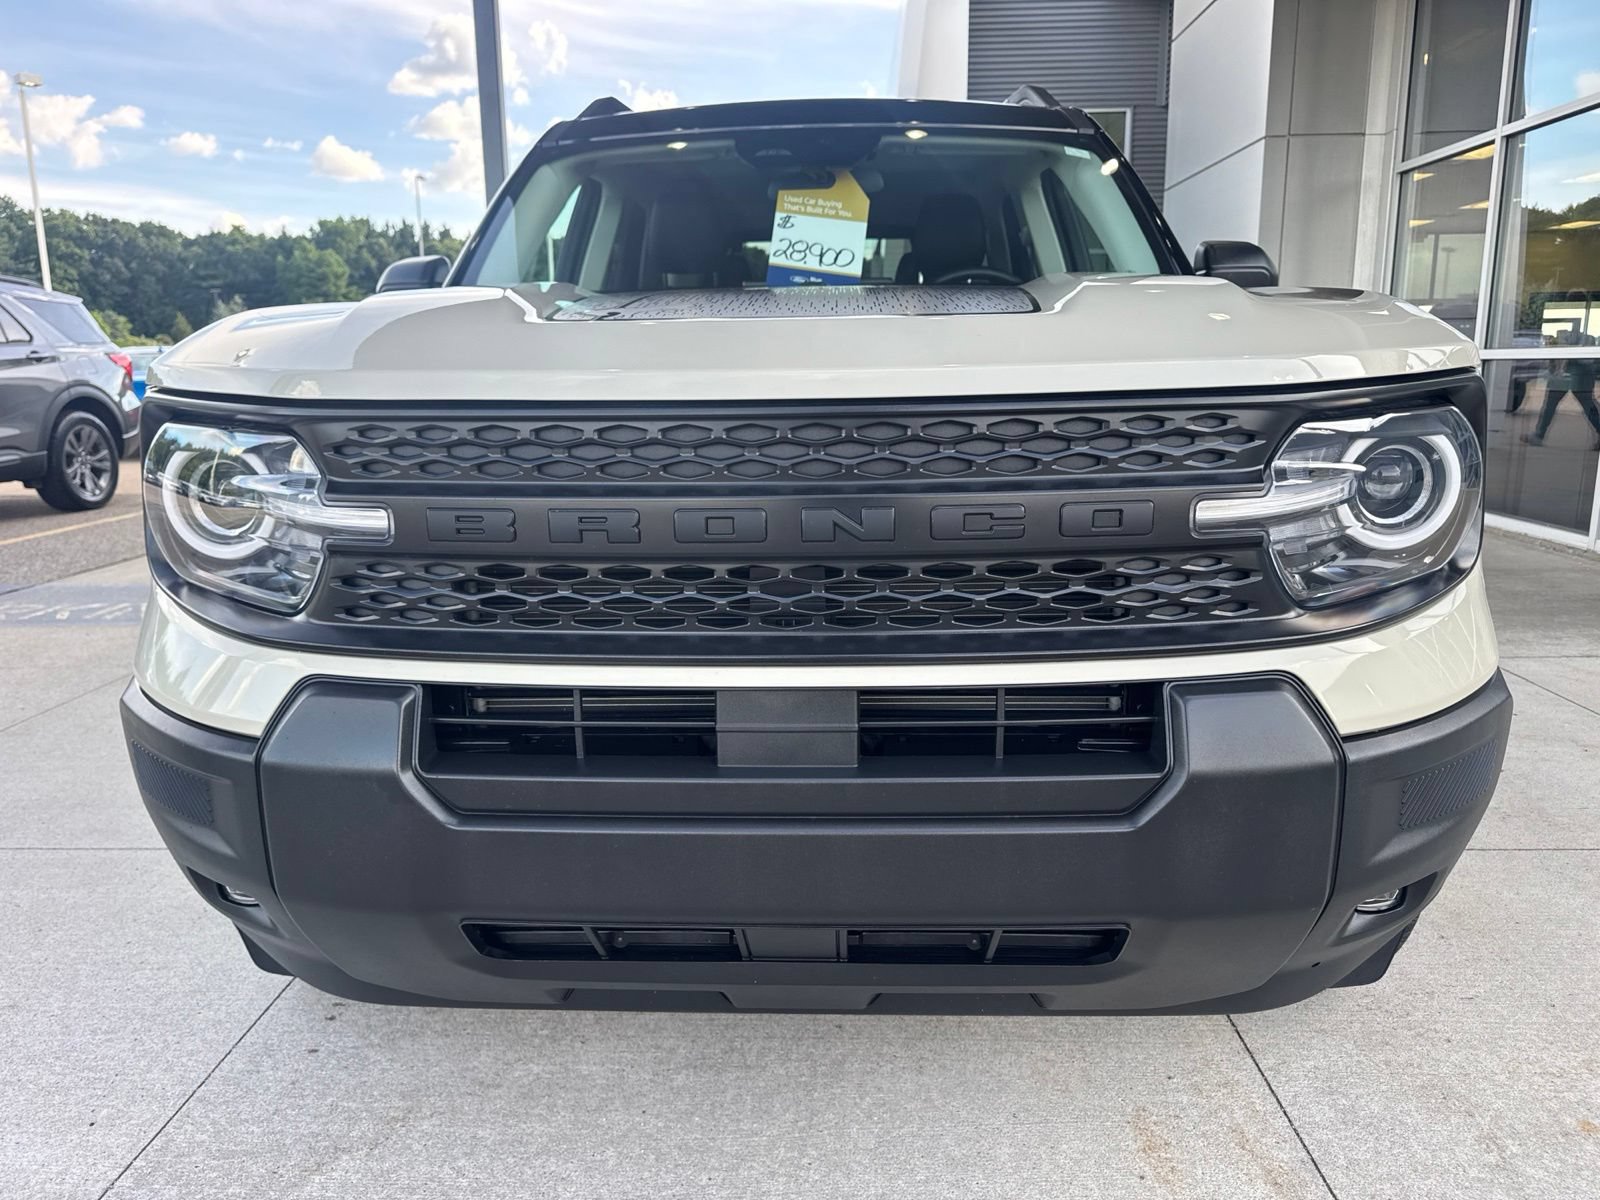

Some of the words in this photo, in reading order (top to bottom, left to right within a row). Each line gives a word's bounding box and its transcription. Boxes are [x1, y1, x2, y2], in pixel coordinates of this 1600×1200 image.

[784, 194, 803, 203] Used
[804, 197, 817, 205] Car
[818, 198, 843, 209] Buying
[777, 215, 796, 229] $
[426, 499, 1154, 543] BRONCO
